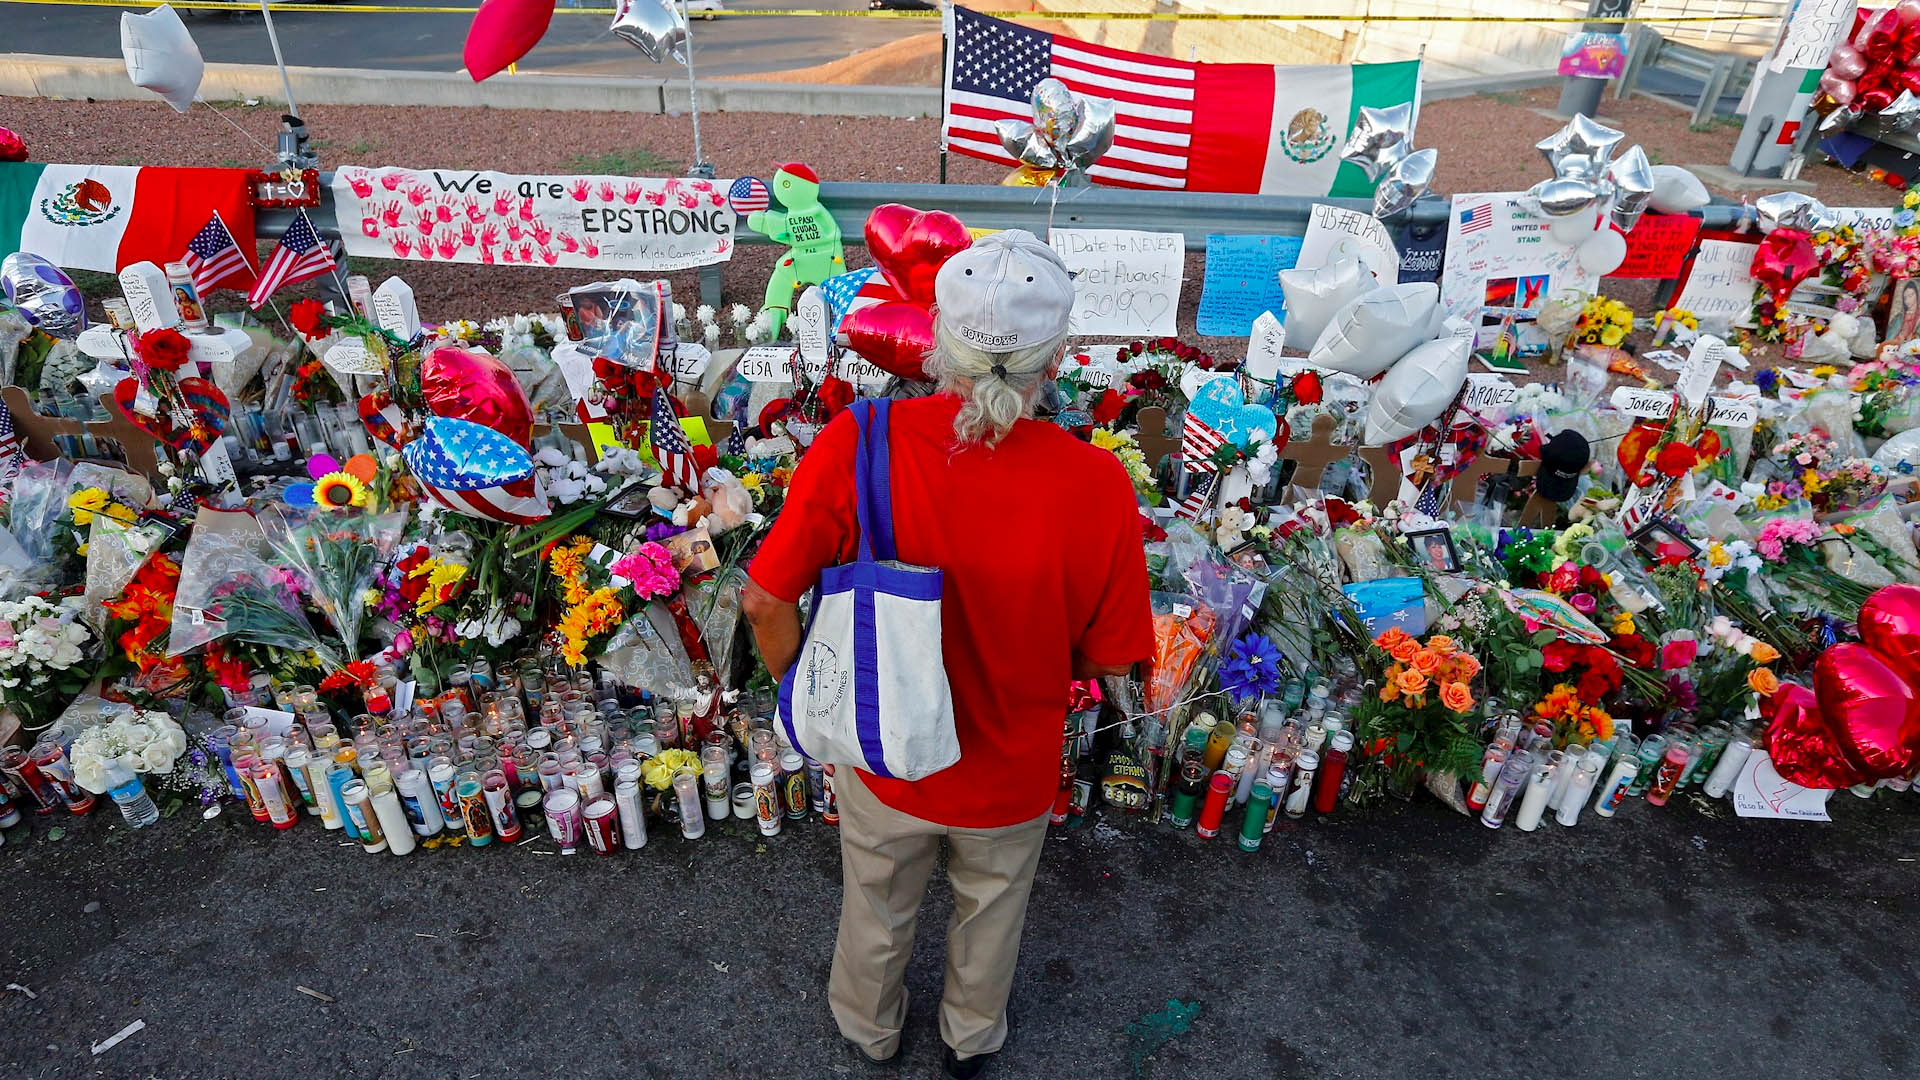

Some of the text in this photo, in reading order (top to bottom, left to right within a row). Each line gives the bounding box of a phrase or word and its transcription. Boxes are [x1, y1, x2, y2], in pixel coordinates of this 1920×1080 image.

[1792, 44, 1829, 65] RIP
[433, 171, 564, 199] We are
[581, 208, 730, 235] EPSTRONG
[789, 216, 814, 226] EL PASO
[792, 224, 818, 234] CIUDAD
[1511, 224, 1538, 232] UNITED
[1849, 209, 1893, 231] Paso
[806, 232, 821, 241] LUZ
[1055, 234, 1067, 256] A
[1070, 234, 1107, 254] Date
[1113, 236, 1127, 251] to
[1516, 236, 1541, 244] STAND
[640, 244, 665, 260] Kids
[667, 244, 706, 259] Campus
[1114, 260, 1168, 284] August
[1084, 288, 1135, 326] 2019
[961, 326, 1018, 346] COWBOYS
[743, 360, 773, 378] ELSA
[1207, 381, 1237, 407] 22
[1463, 384, 1516, 406] ARQUEZ
[817, 708, 830, 718] FOR
[1738, 801, 1756, 810] Paso
